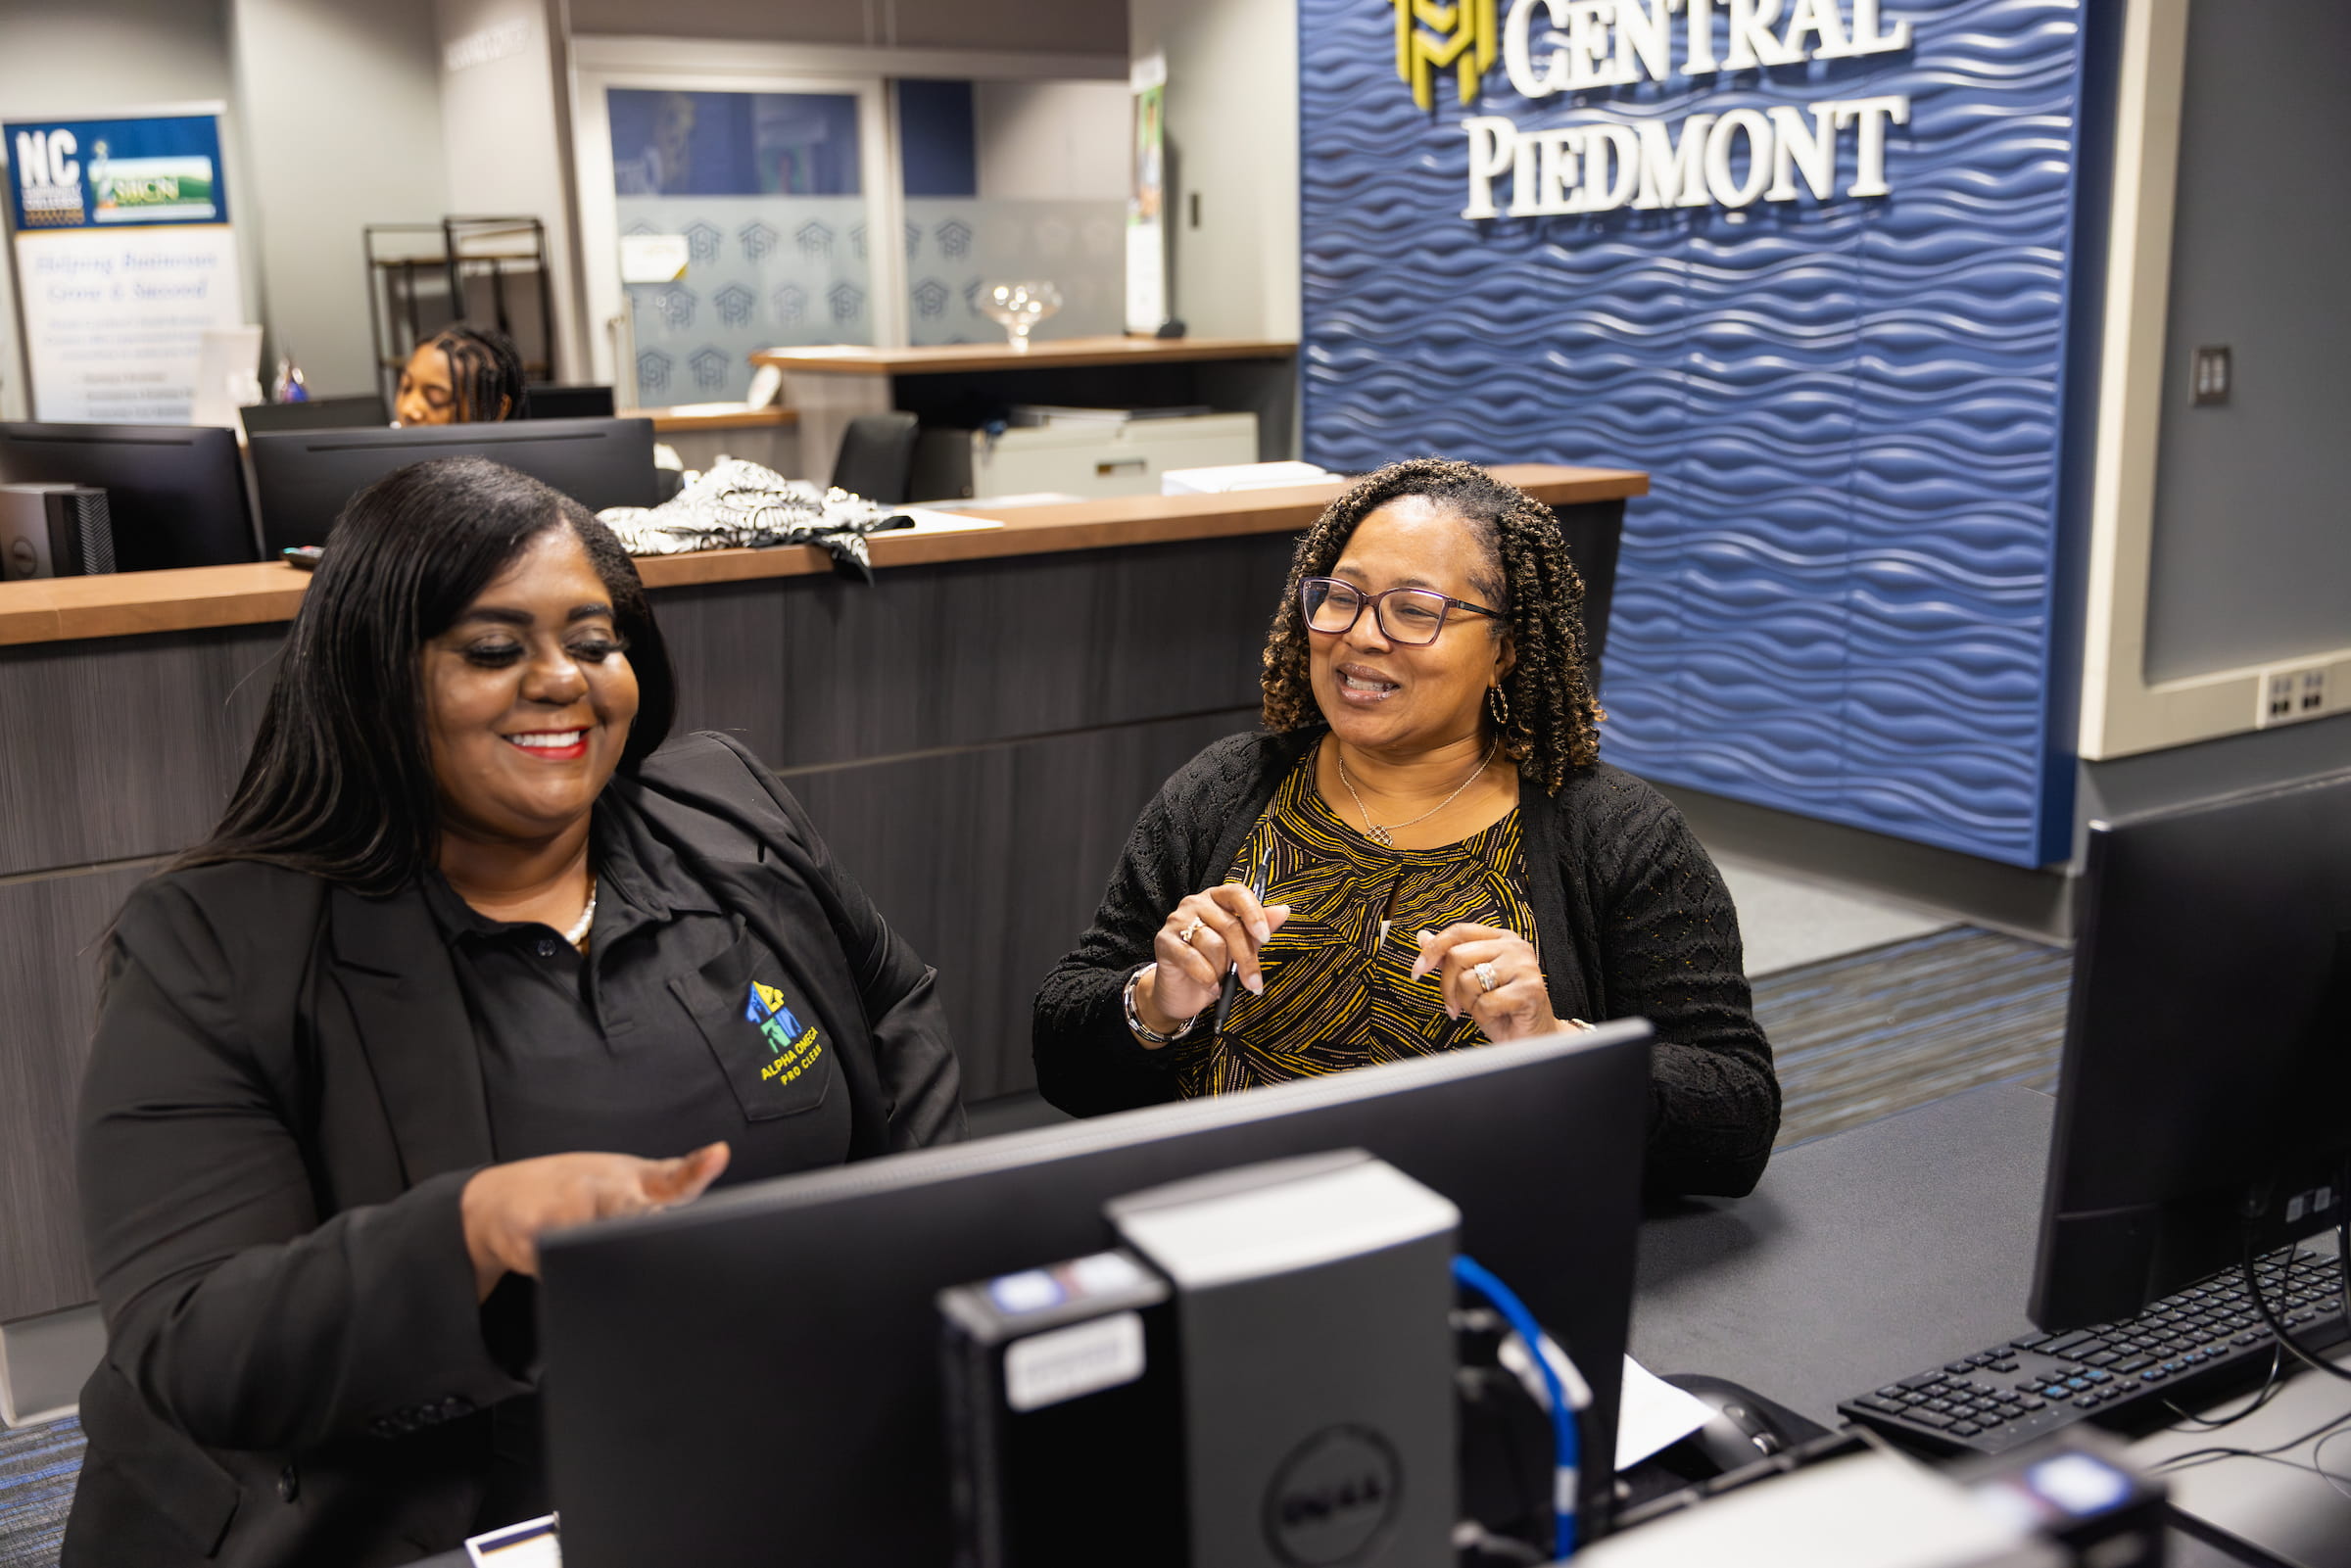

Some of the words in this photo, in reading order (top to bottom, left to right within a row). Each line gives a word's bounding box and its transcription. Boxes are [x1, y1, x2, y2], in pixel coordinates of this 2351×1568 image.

[1504, 0, 1910, 97] CENTRAL
[16, 128, 80, 188] NC
[1462, 96, 1909, 218] PIEDMONT
[761, 1050, 797, 1080] ALPHA
[794, 1026, 818, 1055] OMEGA
[780, 1066, 801, 1085] PRO
[800, 1043, 822, 1069] CLEAN
